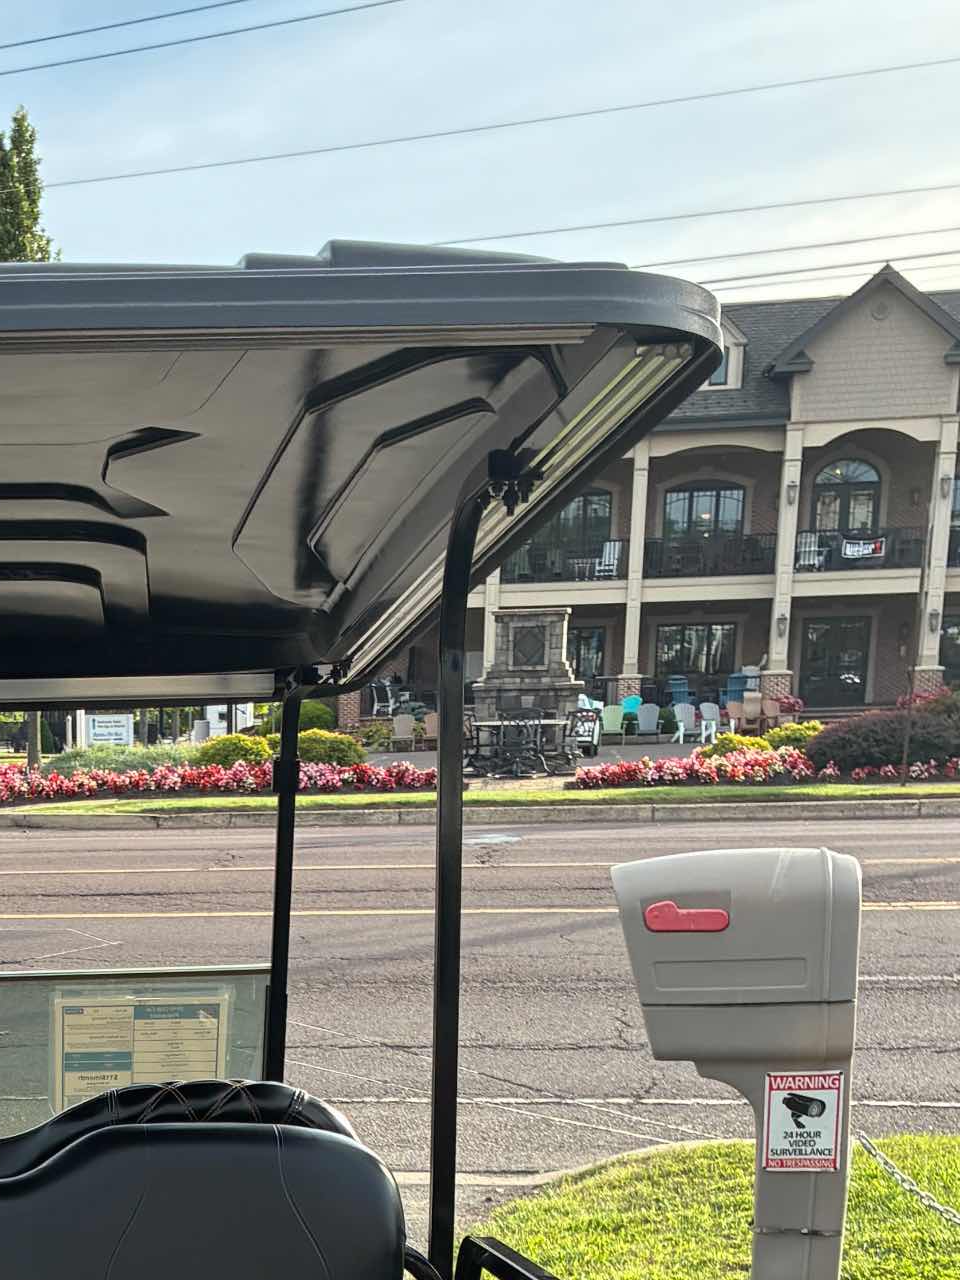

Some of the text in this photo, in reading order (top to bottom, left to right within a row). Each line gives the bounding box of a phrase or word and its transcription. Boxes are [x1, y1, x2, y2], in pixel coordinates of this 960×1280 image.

[771, 1076, 840, 1089] WARNING
[783, 1131, 821, 1139] 24 HOUR
[770, 1148, 832, 1156] SURVEILLANCE
[768, 1159, 834, 1168] NO TRESPASSING
